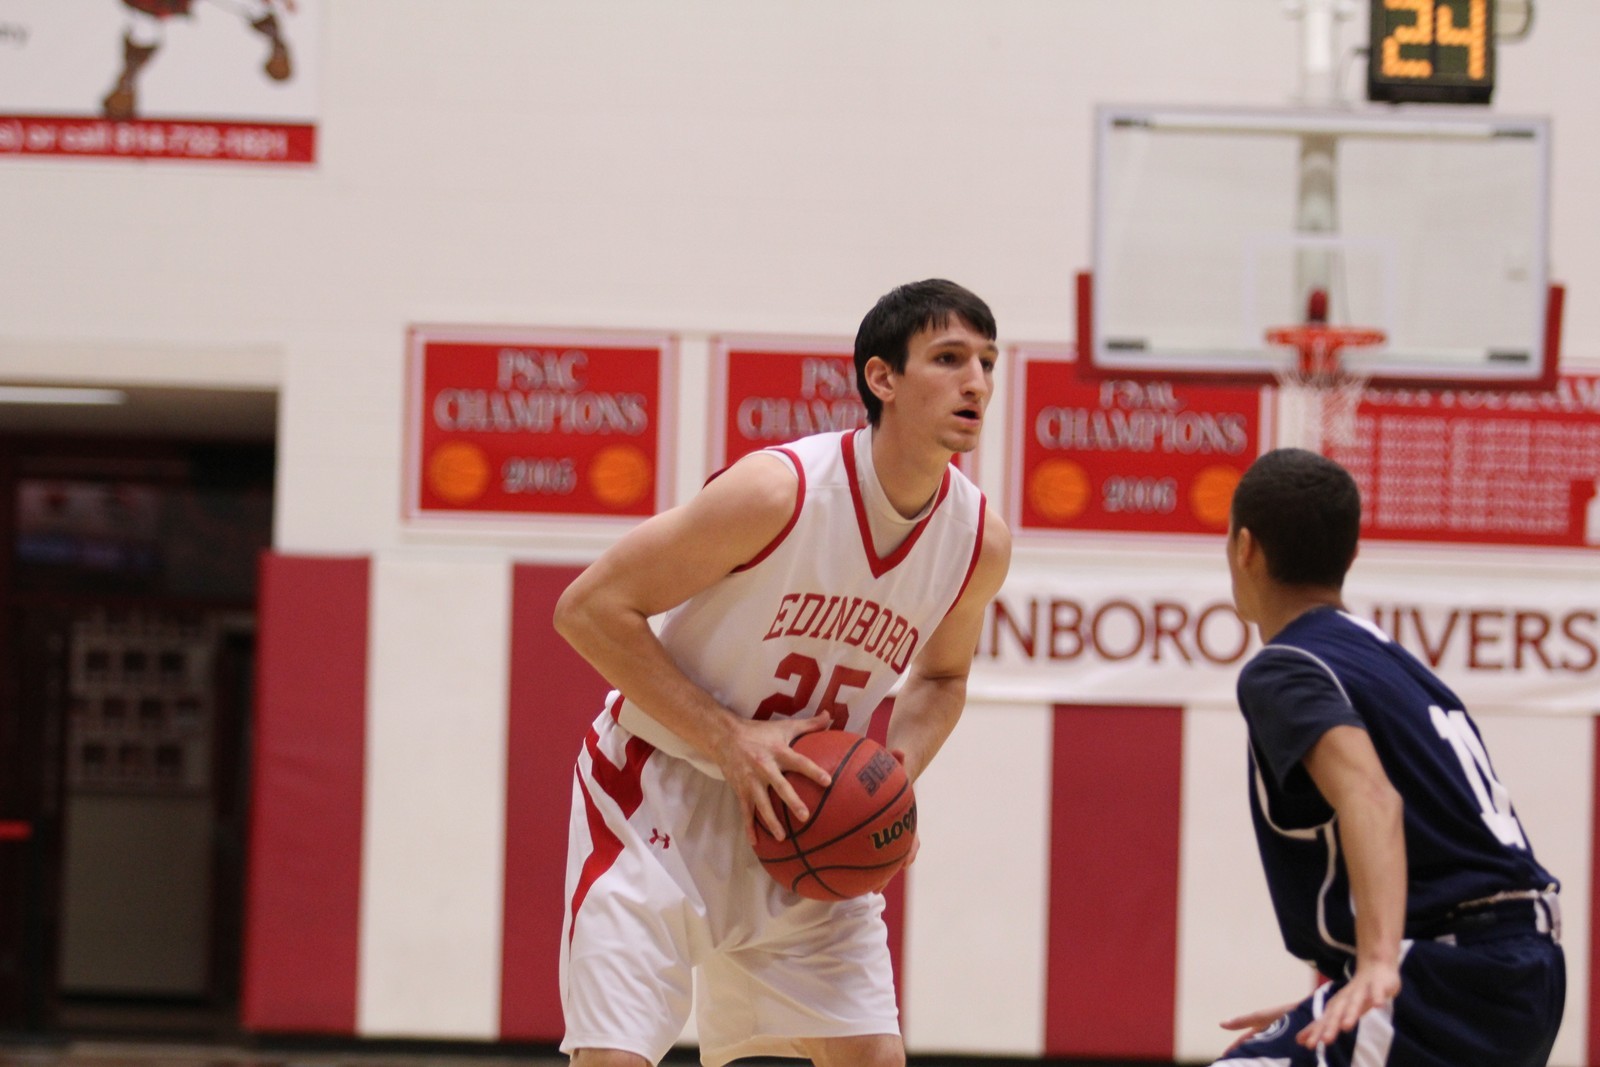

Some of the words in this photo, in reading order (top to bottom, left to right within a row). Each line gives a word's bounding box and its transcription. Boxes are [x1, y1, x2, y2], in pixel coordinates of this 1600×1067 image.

[1381, 0, 1487, 80] 24
[24, 122, 56, 150] or
[498, 348, 588, 391] PSAC
[433, 387, 647, 434] CHAMPIONS
[1036, 405, 1247, 455] CHAMPIONS
[763, 593, 919, 675] EDINBORO
[972, 598, 1249, 664] NBORO
[752, 652, 871, 730] 25
